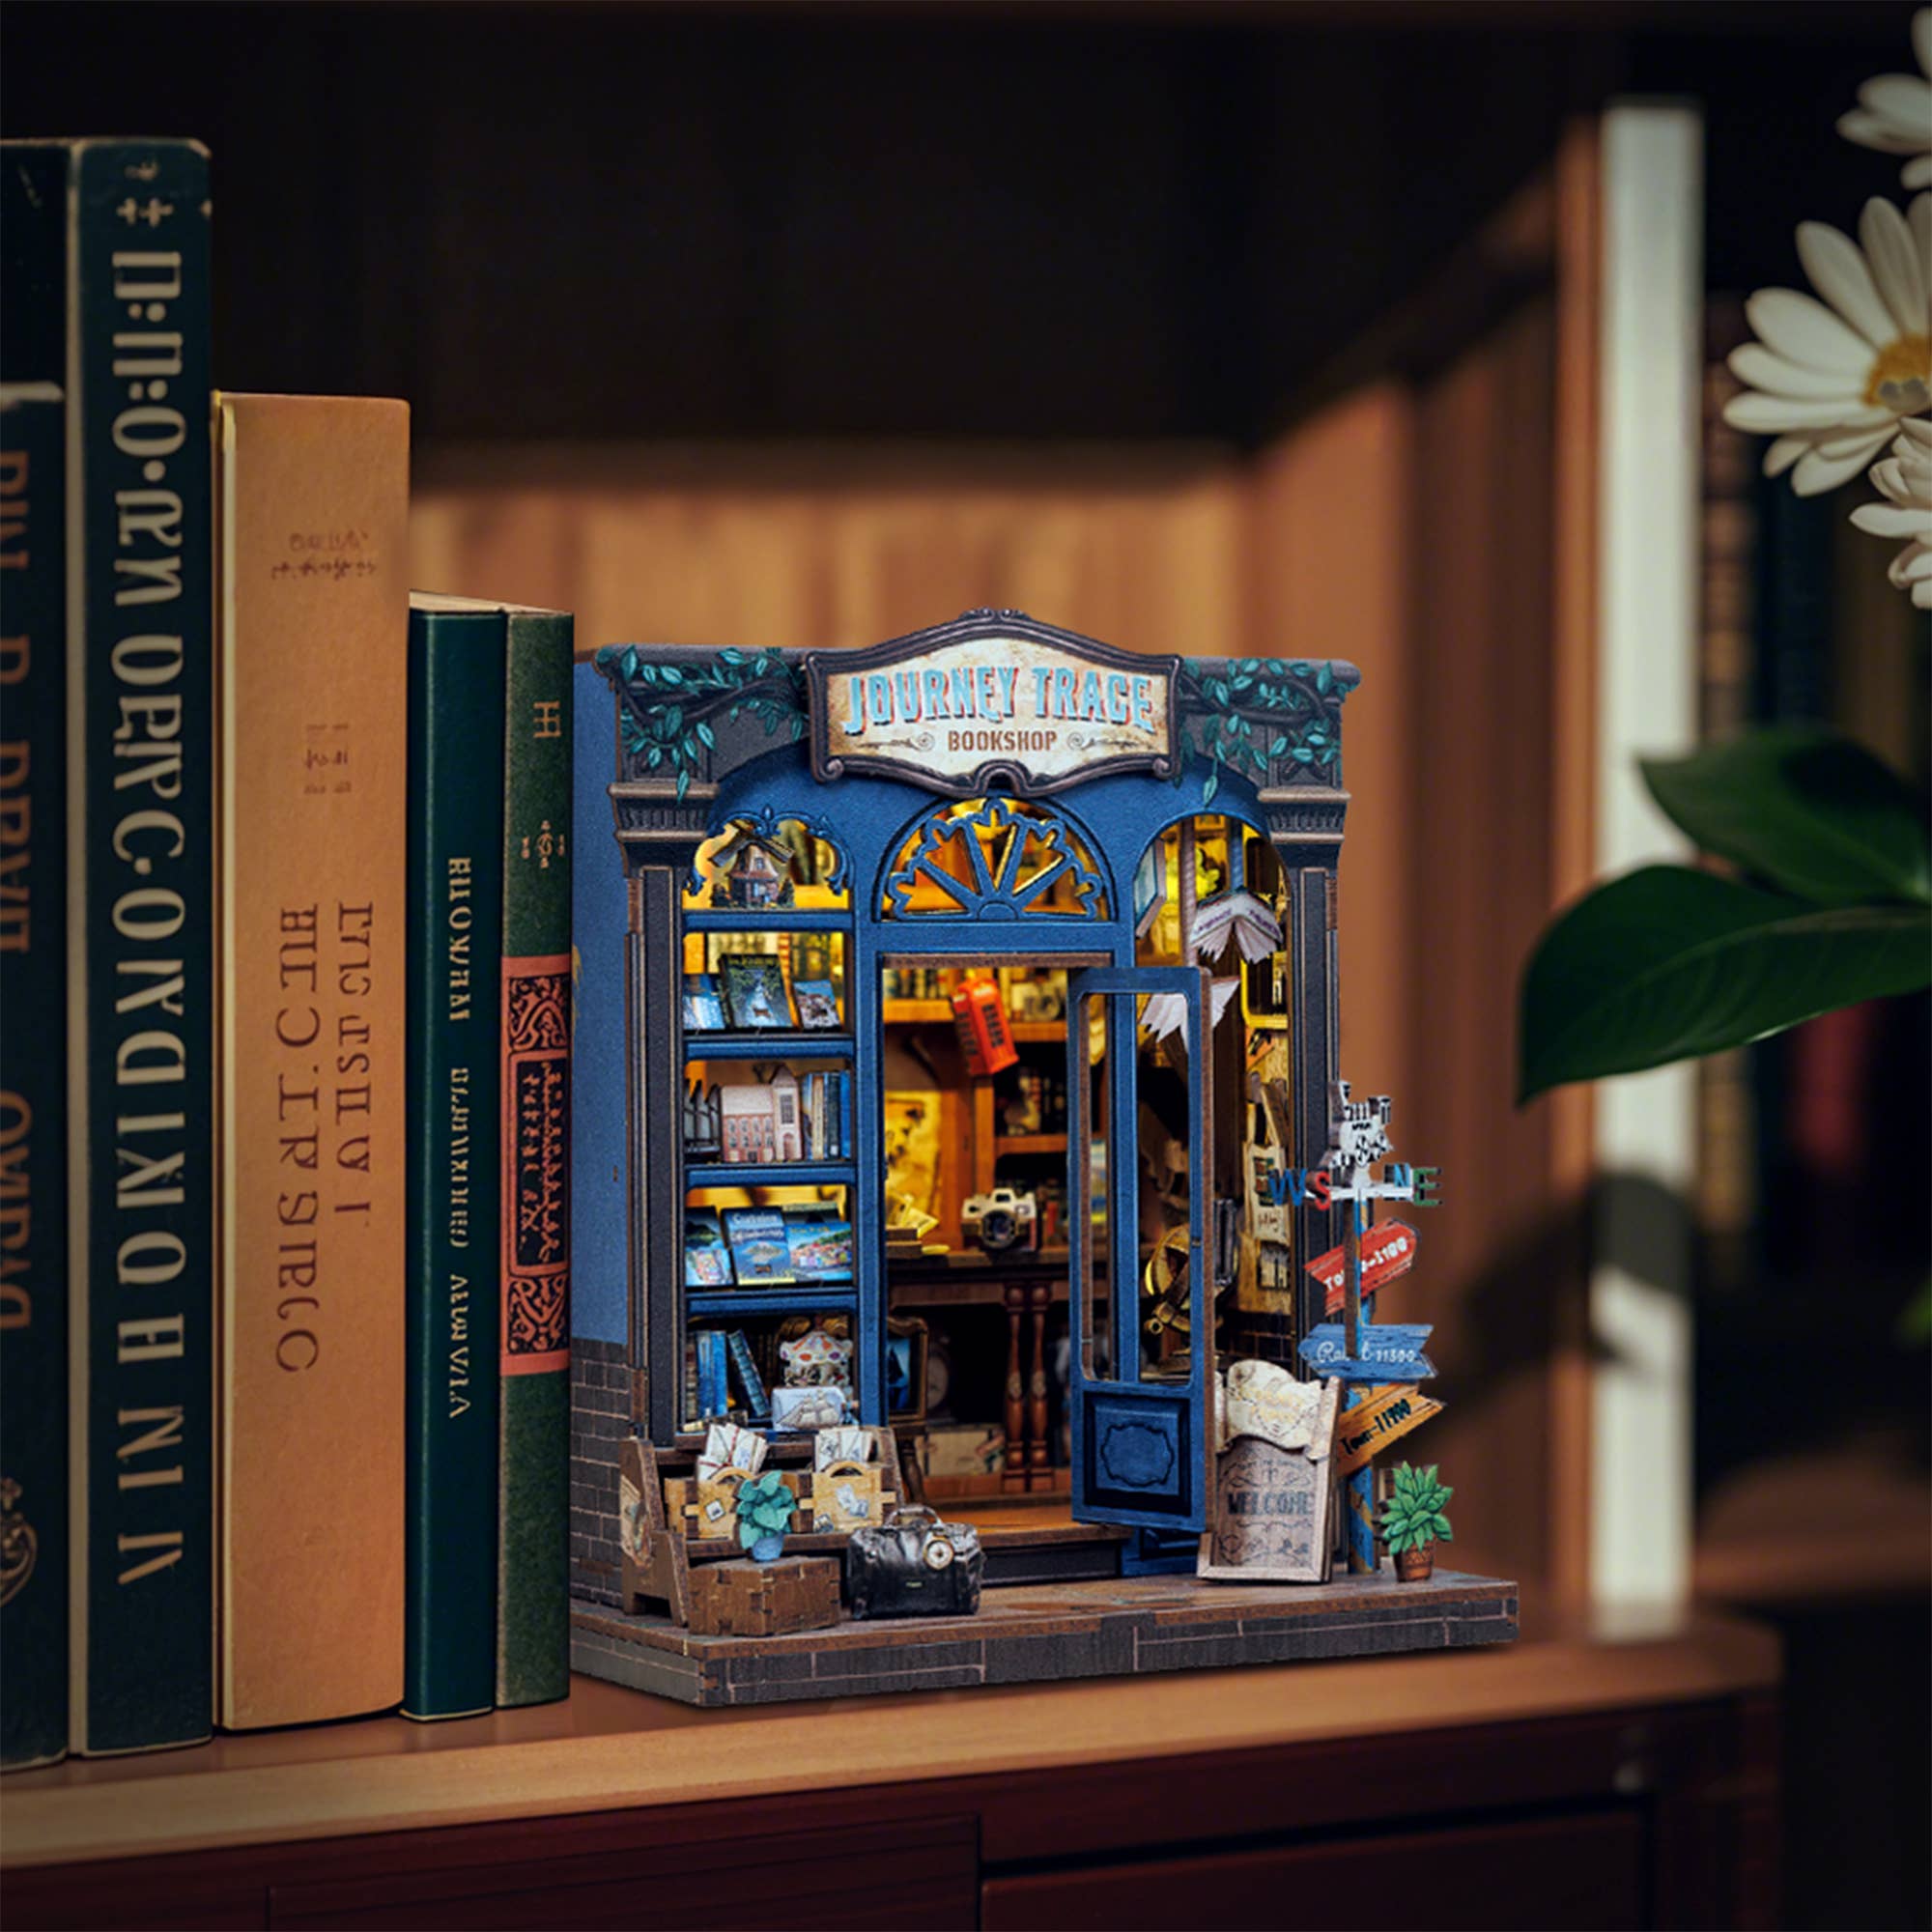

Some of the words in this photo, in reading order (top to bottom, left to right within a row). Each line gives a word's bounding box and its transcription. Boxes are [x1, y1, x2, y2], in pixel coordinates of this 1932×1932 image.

[843, 667, 1019, 736] JOURNEY
[1032, 667, 1156, 734] TRACE
[948, 730, 1058, 752] BOOKSHOP
[1226, 1490, 1314, 1516] WELCOME
